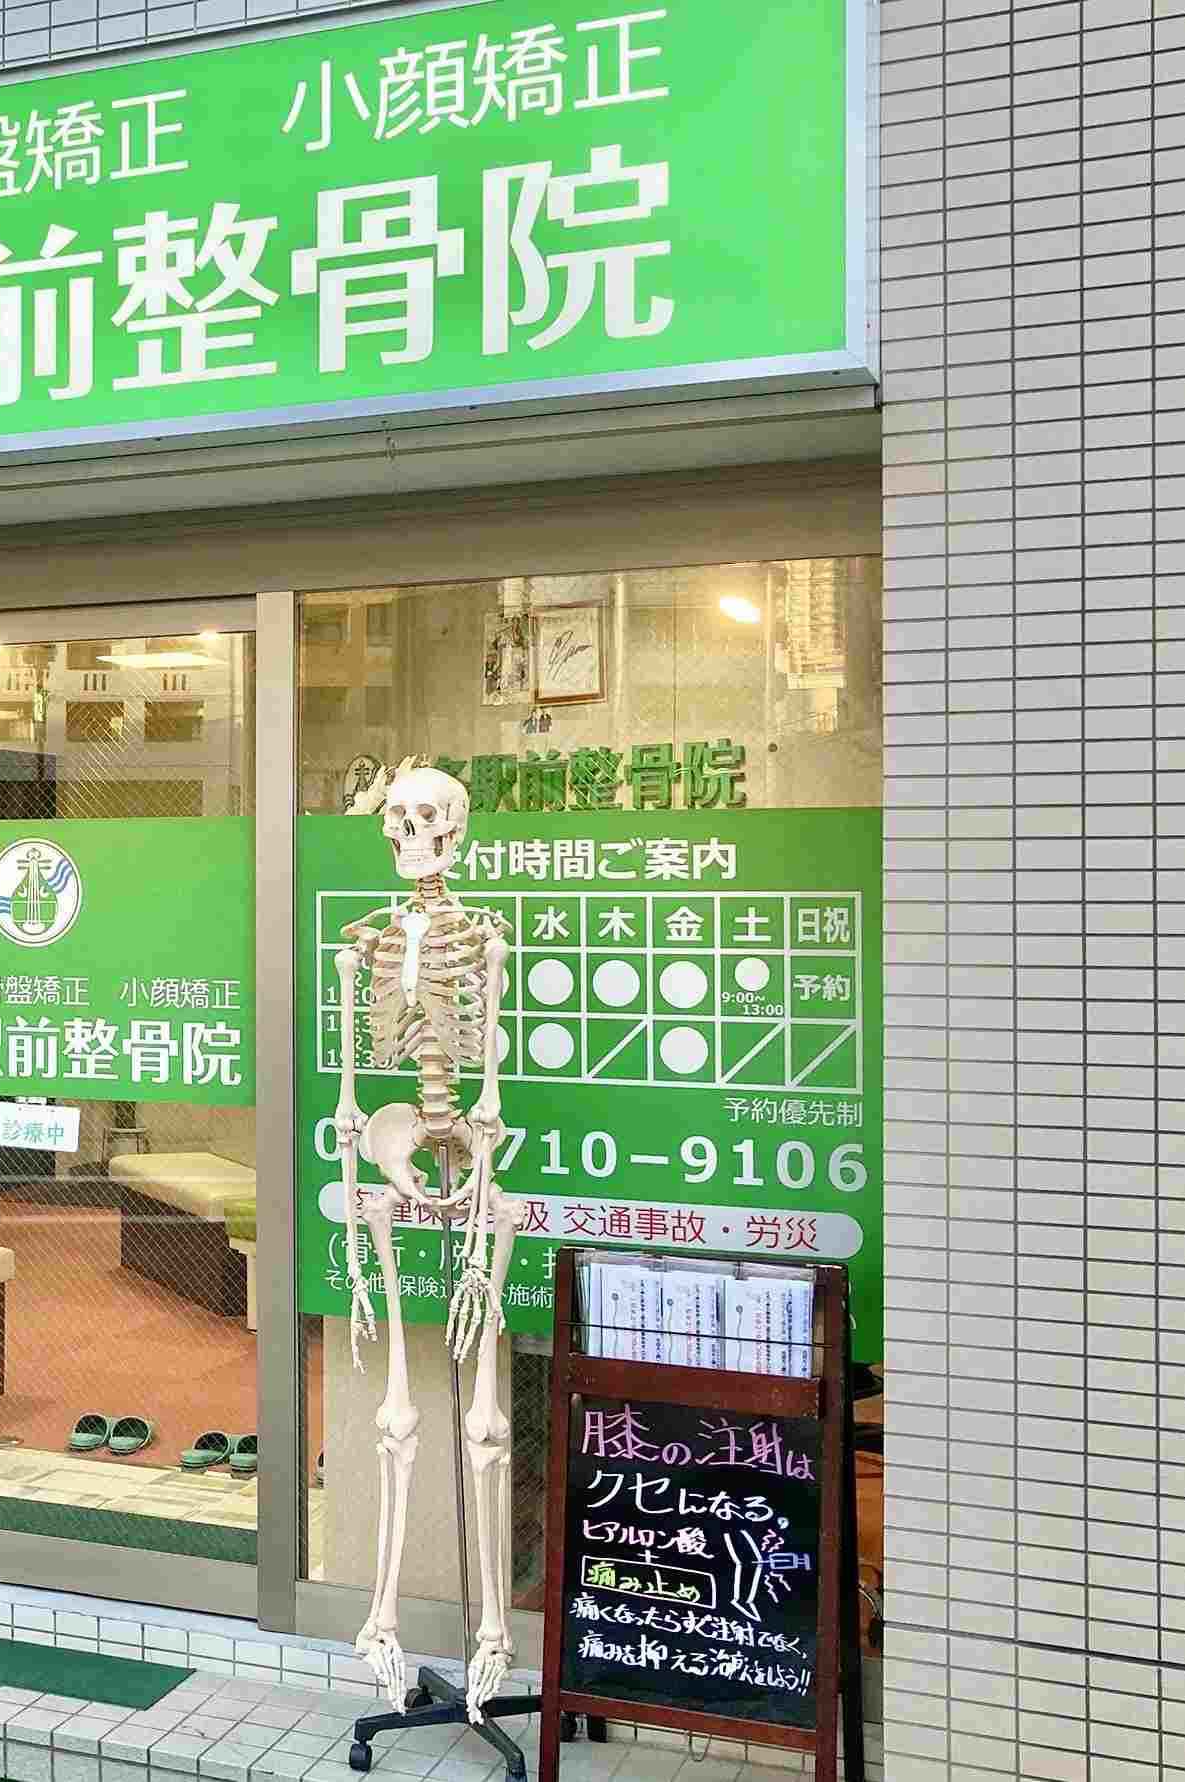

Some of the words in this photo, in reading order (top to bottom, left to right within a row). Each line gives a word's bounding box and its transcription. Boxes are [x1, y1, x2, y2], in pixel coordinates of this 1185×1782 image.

[282, 9, 669, 152] 小顔矯正
[532, 906, 570, 940] 水
[598, 906, 635, 941] 木
[665, 906, 704, 942] 金
[733, 907, 771, 942] 土
[797, 907, 850, 943] 日祝
[120, 976, 242, 1010] 小顔矯正
[793, 974, 850, 1001] 予約
[2, 1118, 66, 1143] 診療中
[724, 1097, 862, 1127] 予約優先制
[562, 1202, 820, 1252] 交通事故・労災
[582, 1404, 815, 1480] 膝の注射は
[583, 1519, 714, 1559] ヒアルロン酸
[587, 1562, 701, 1602] 痛み止め
